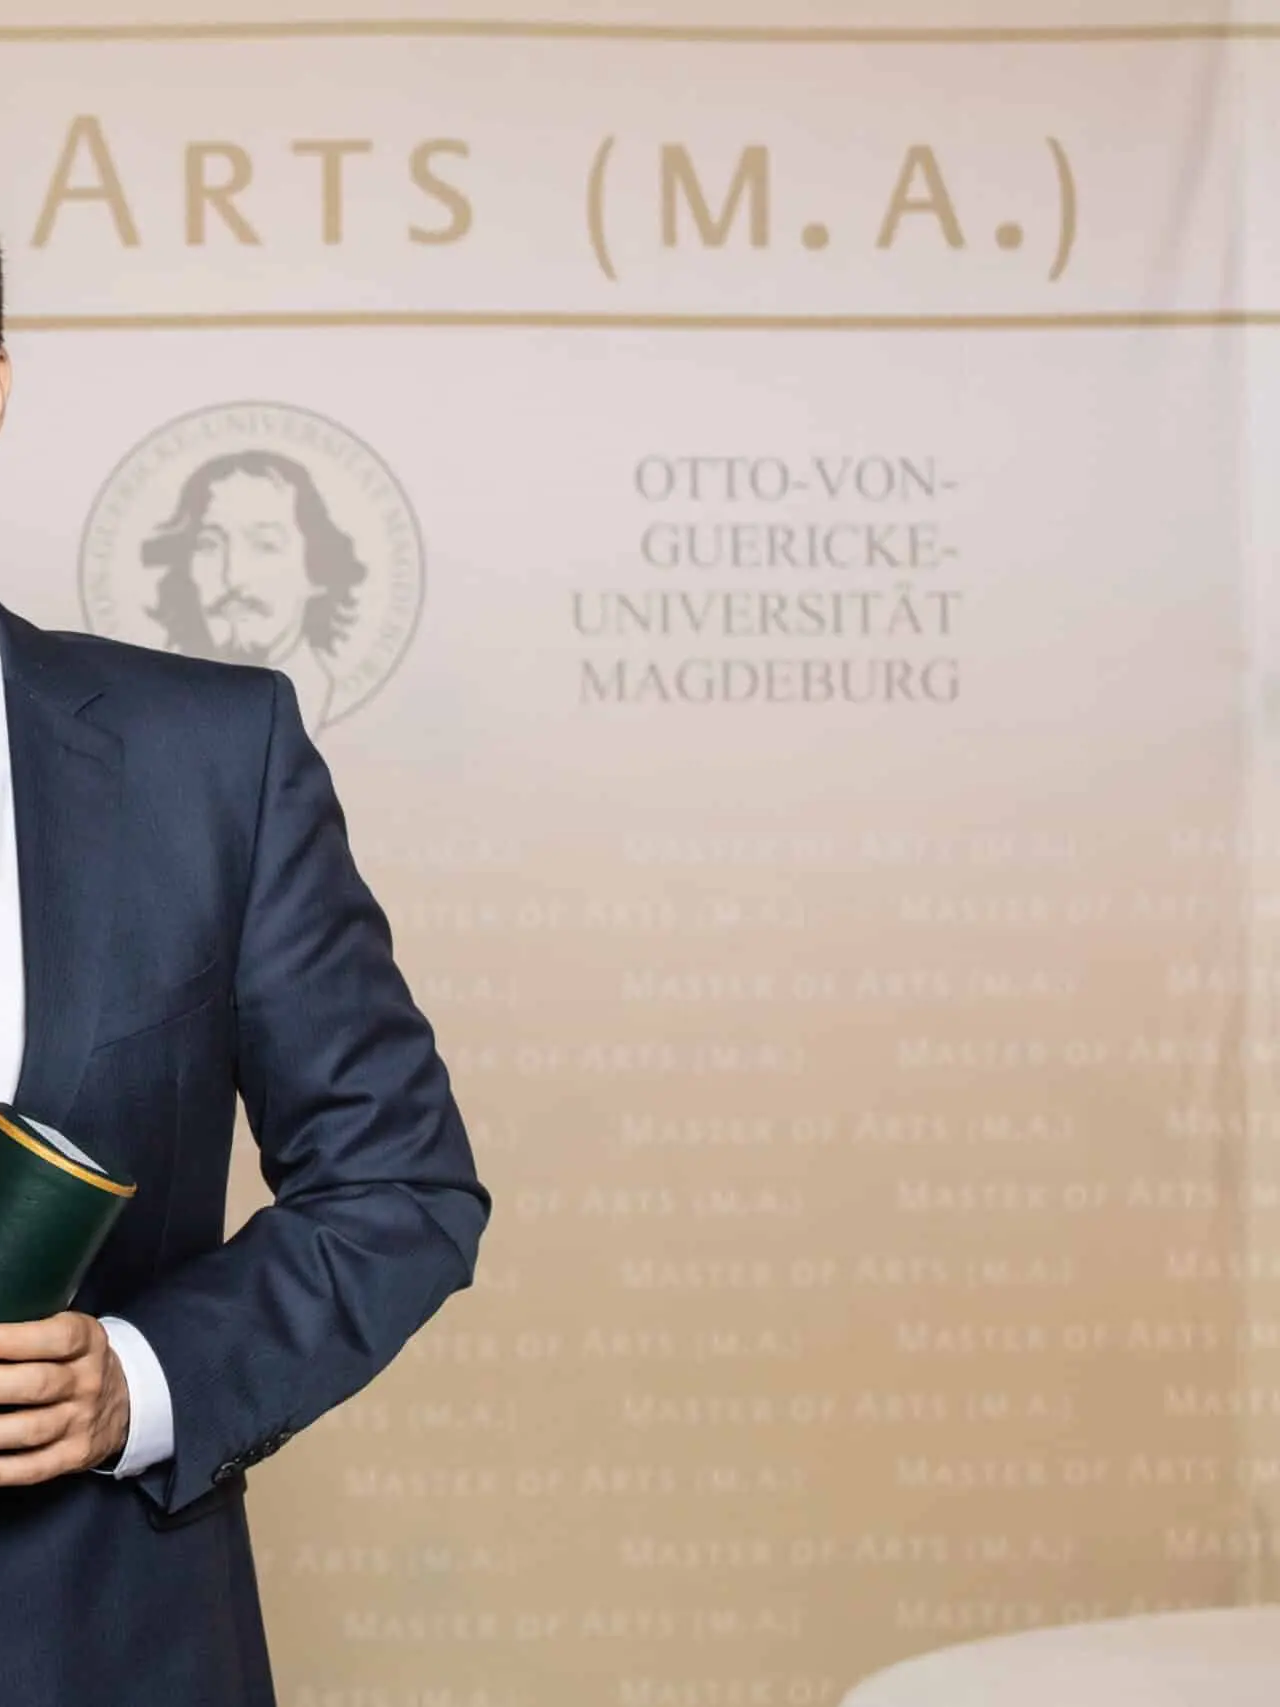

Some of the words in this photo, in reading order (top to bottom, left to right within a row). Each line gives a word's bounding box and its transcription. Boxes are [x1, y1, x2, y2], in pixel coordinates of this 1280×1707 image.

[29, 115, 473, 249] ARTS
[633, 456, 961, 503] OTTO-VON-
[640, 522, 960, 572] GUERICKE-
[570, 580, 963, 637] UNIVERSITÄT
[578, 657, 962, 706] MAGDEBURG
